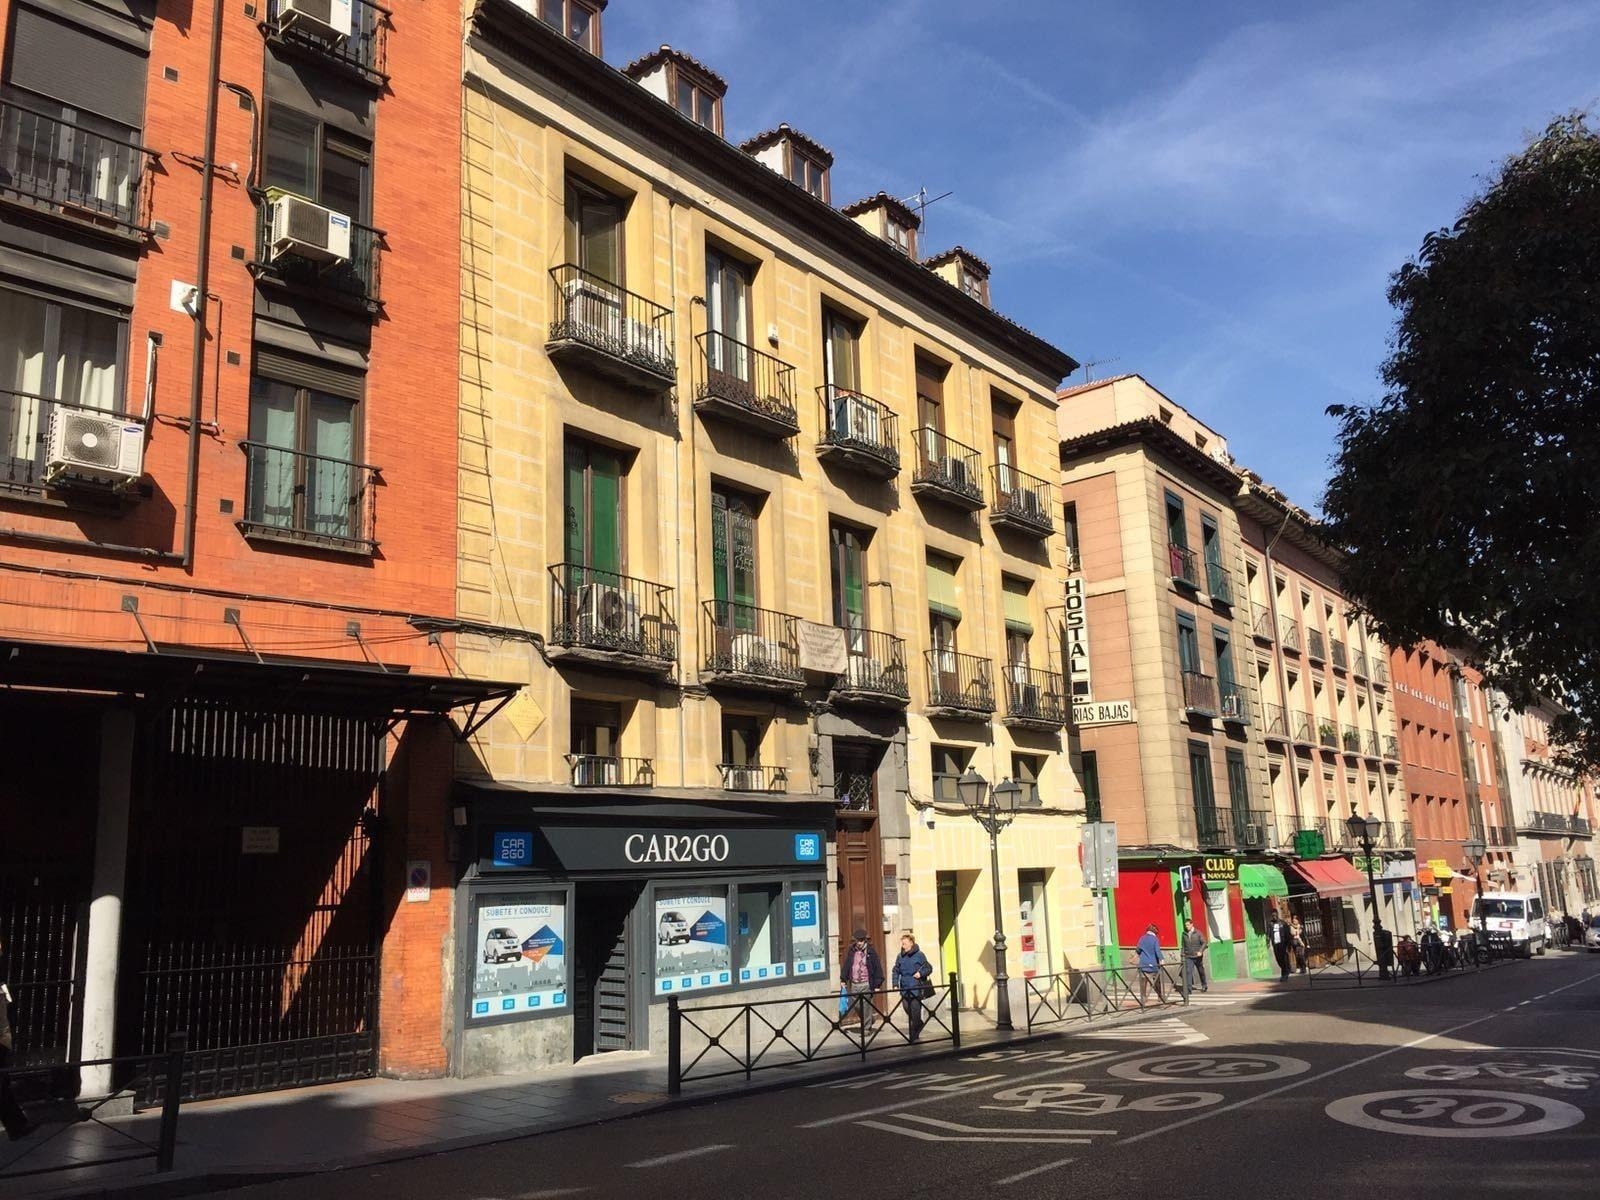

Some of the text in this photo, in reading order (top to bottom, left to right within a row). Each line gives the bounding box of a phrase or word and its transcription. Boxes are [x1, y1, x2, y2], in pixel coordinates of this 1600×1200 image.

[1065, 579, 1087, 673] HOSTAL
[1073, 704, 1129, 721] RIAS BAJAS
[501, 839, 525, 849] CAR
[800, 839, 815, 847] CAR
[624, 834, 730, 863] CAR2GO
[800, 847, 815, 855] 2GO
[501, 849, 525, 859] 2GO
[1205, 859, 1235, 871] CLUB
[794, 901, 810, 910] CAR
[514, 908, 519, 916] Y
[520, 906, 549, 914] CONDUCE
[794, 910, 810, 920] 2GO
[1151, 1059, 1267, 1077] 30
[1380, 1097, 1526, 1125] 30
